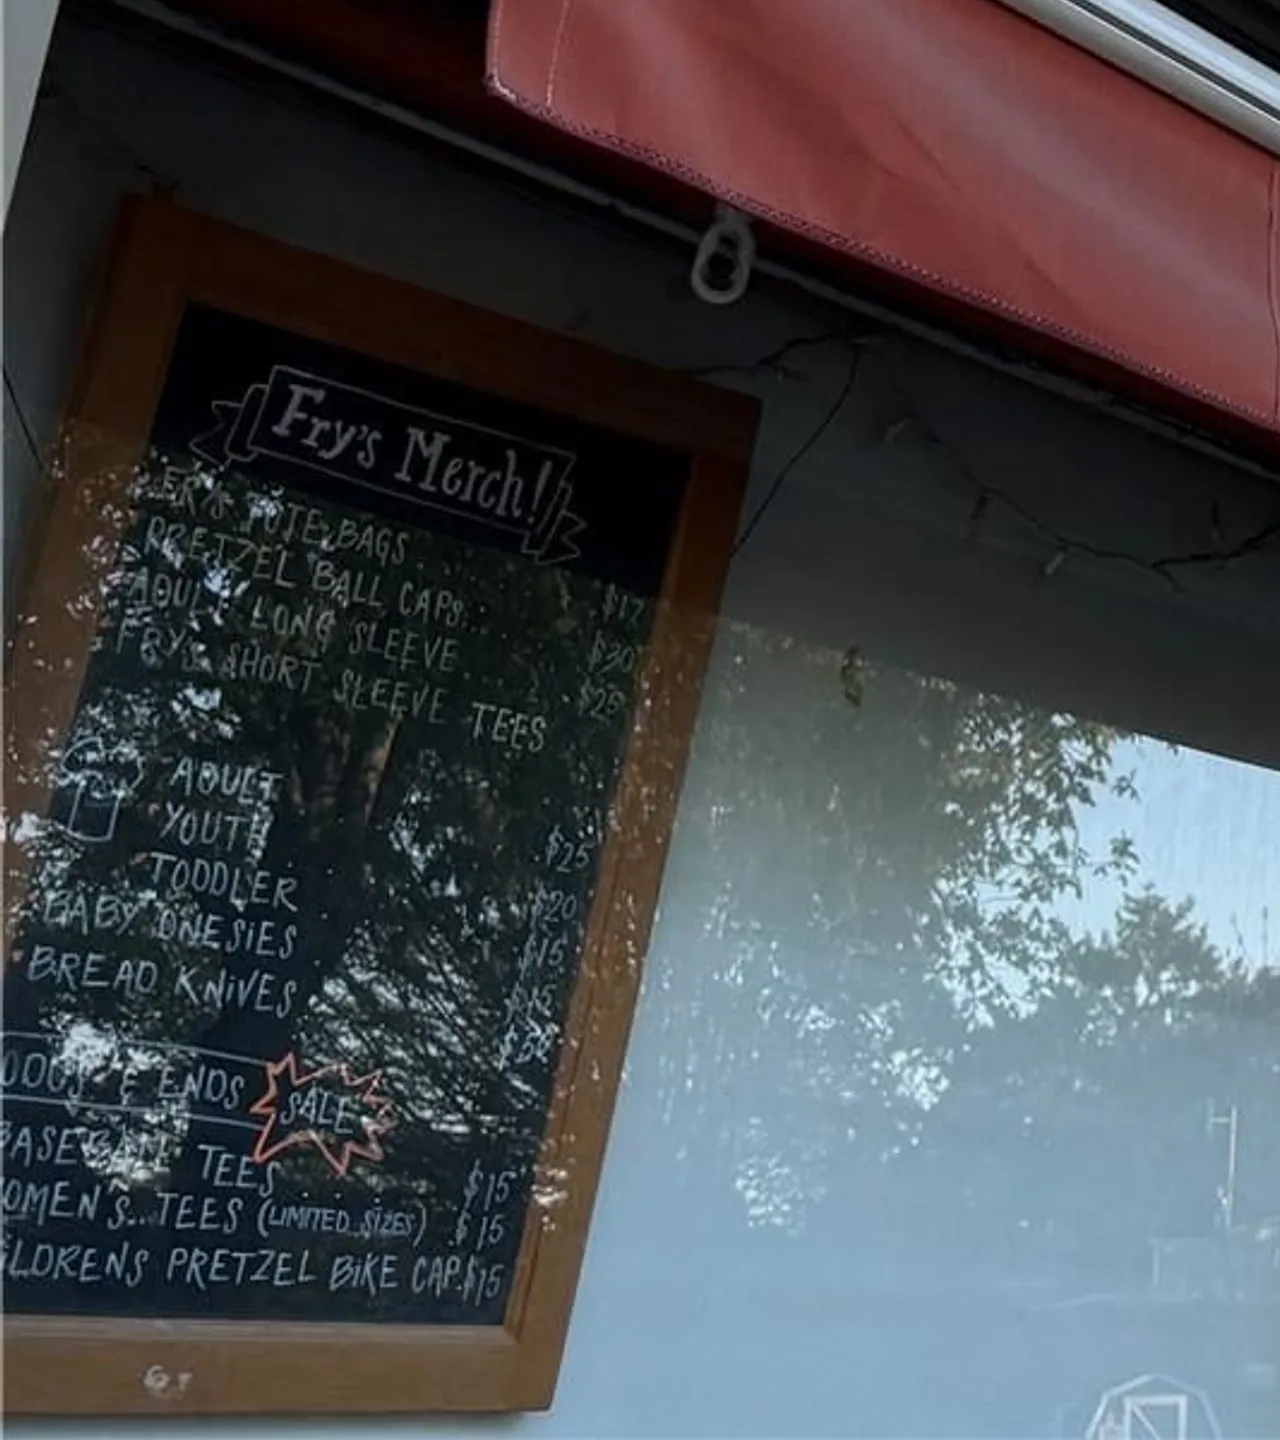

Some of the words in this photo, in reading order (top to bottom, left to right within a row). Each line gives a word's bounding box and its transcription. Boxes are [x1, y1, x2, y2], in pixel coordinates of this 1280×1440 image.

[271, 383, 383, 469] Fry's
[394, 426, 553, 525] Merch!
[144, 515, 296, 589] PRETZEL
[311, 559, 384, 608] BALL
[336, 518, 409, 567] BAGS
[250, 596, 336, 653] LONG
[349, 621, 460, 672] SLEEVE
[222, 642, 321, 693] SHORT
[333, 669, 449, 725] SLEEVE
[472, 701, 547, 753] TEES
[159, 800, 272, 858] YOUTH
[169, 755, 284, 806] ADULT
[546, 823, 596, 873] $25
[150, 851, 298, 911] TODDLER
[43, 890, 141, 935] BABY
[27, 945, 158, 997] BREAD
[158, 1064, 245, 1109] ENDS
[280, 1081, 354, 1134] SALE
[197, 1143, 283, 1198] TEES
[463, 1159, 516, 1211] $15
[155, 1192, 244, 1234] TEES
[454, 1212, 505, 1252] $15
[167, 1246, 317, 1291] PRETZEL
[462, 1256, 505, 1307] $15
